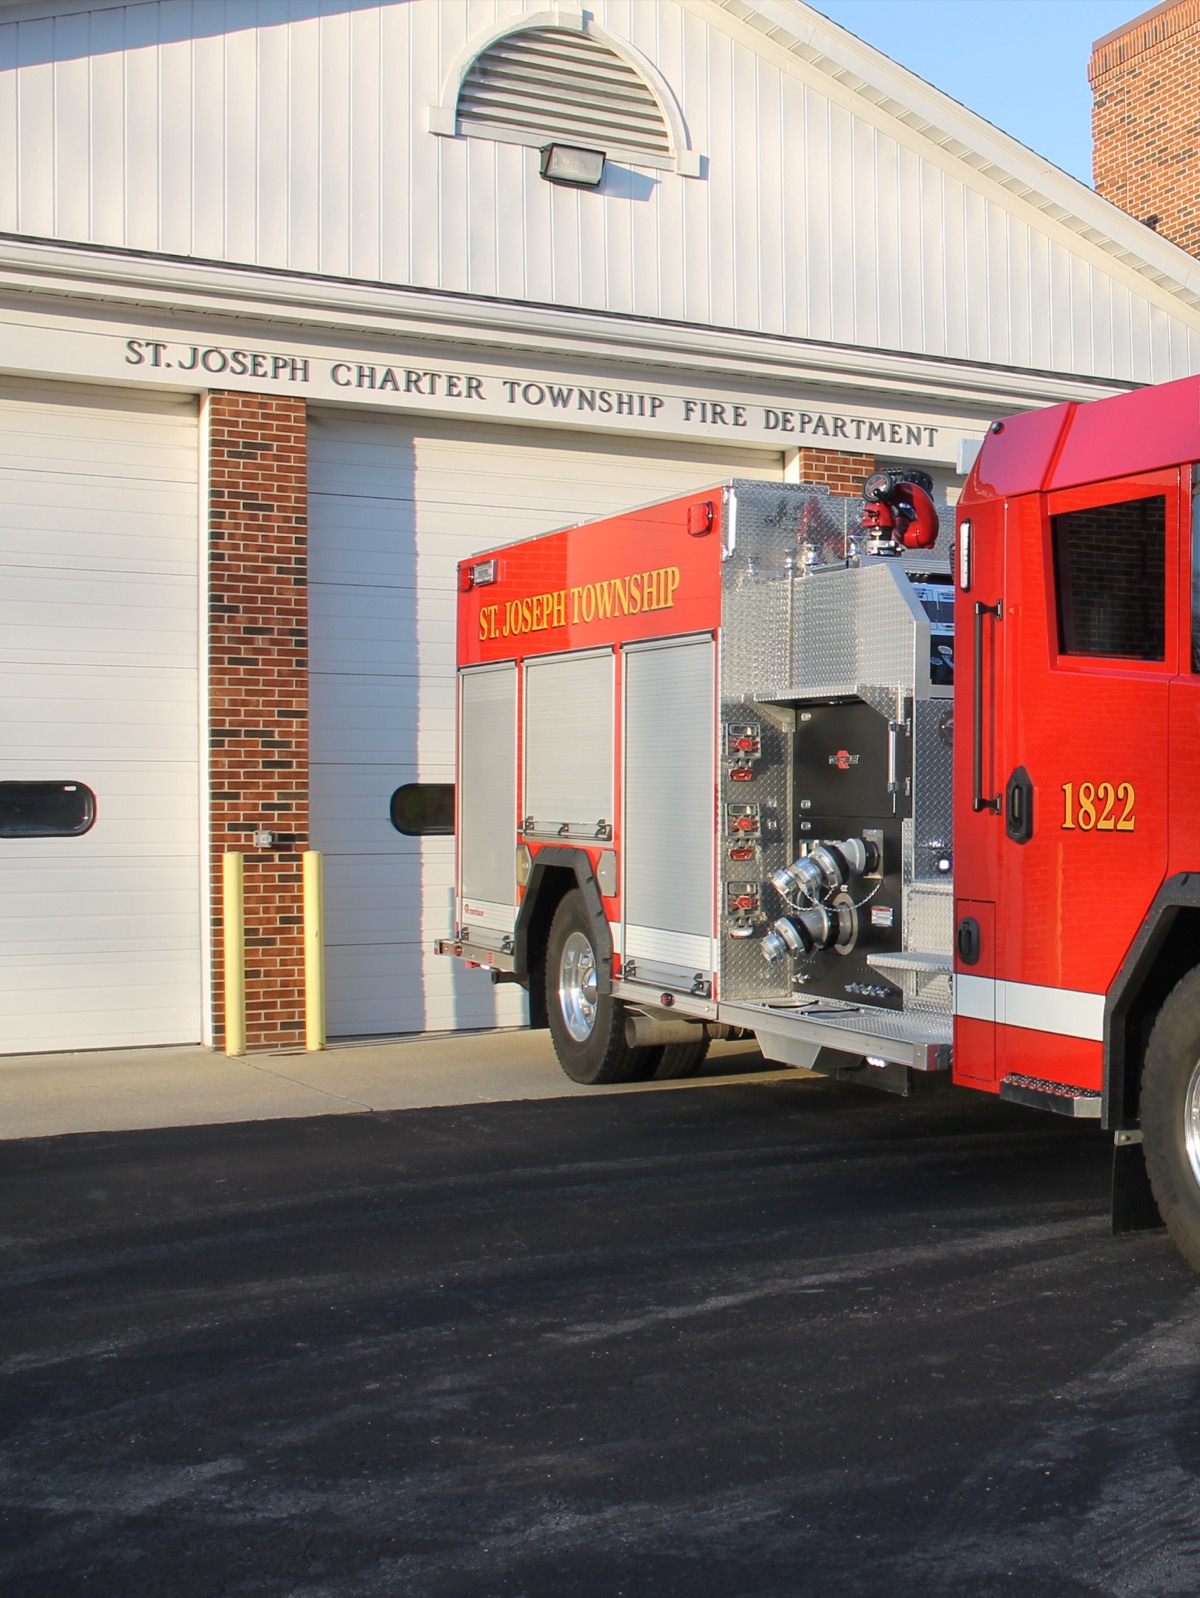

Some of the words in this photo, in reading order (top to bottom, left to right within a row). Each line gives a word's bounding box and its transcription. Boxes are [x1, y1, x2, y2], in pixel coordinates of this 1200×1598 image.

[125, 340, 173, 367] ST.
[178, 347, 310, 382] JOSEPH
[330, 363, 486, 400] CHARTER
[502, 380, 665, 418] TOWNSHIP
[683, 400, 748, 427] FIRE
[763, 408, 939, 447] DEPARTMENT
[479, 604, 500, 641] ST.
[502, 590, 567, 638] JOSEPH
[569, 566, 680, 624] TOWNSHIP
[1061, 782, 1136, 831] 1822
